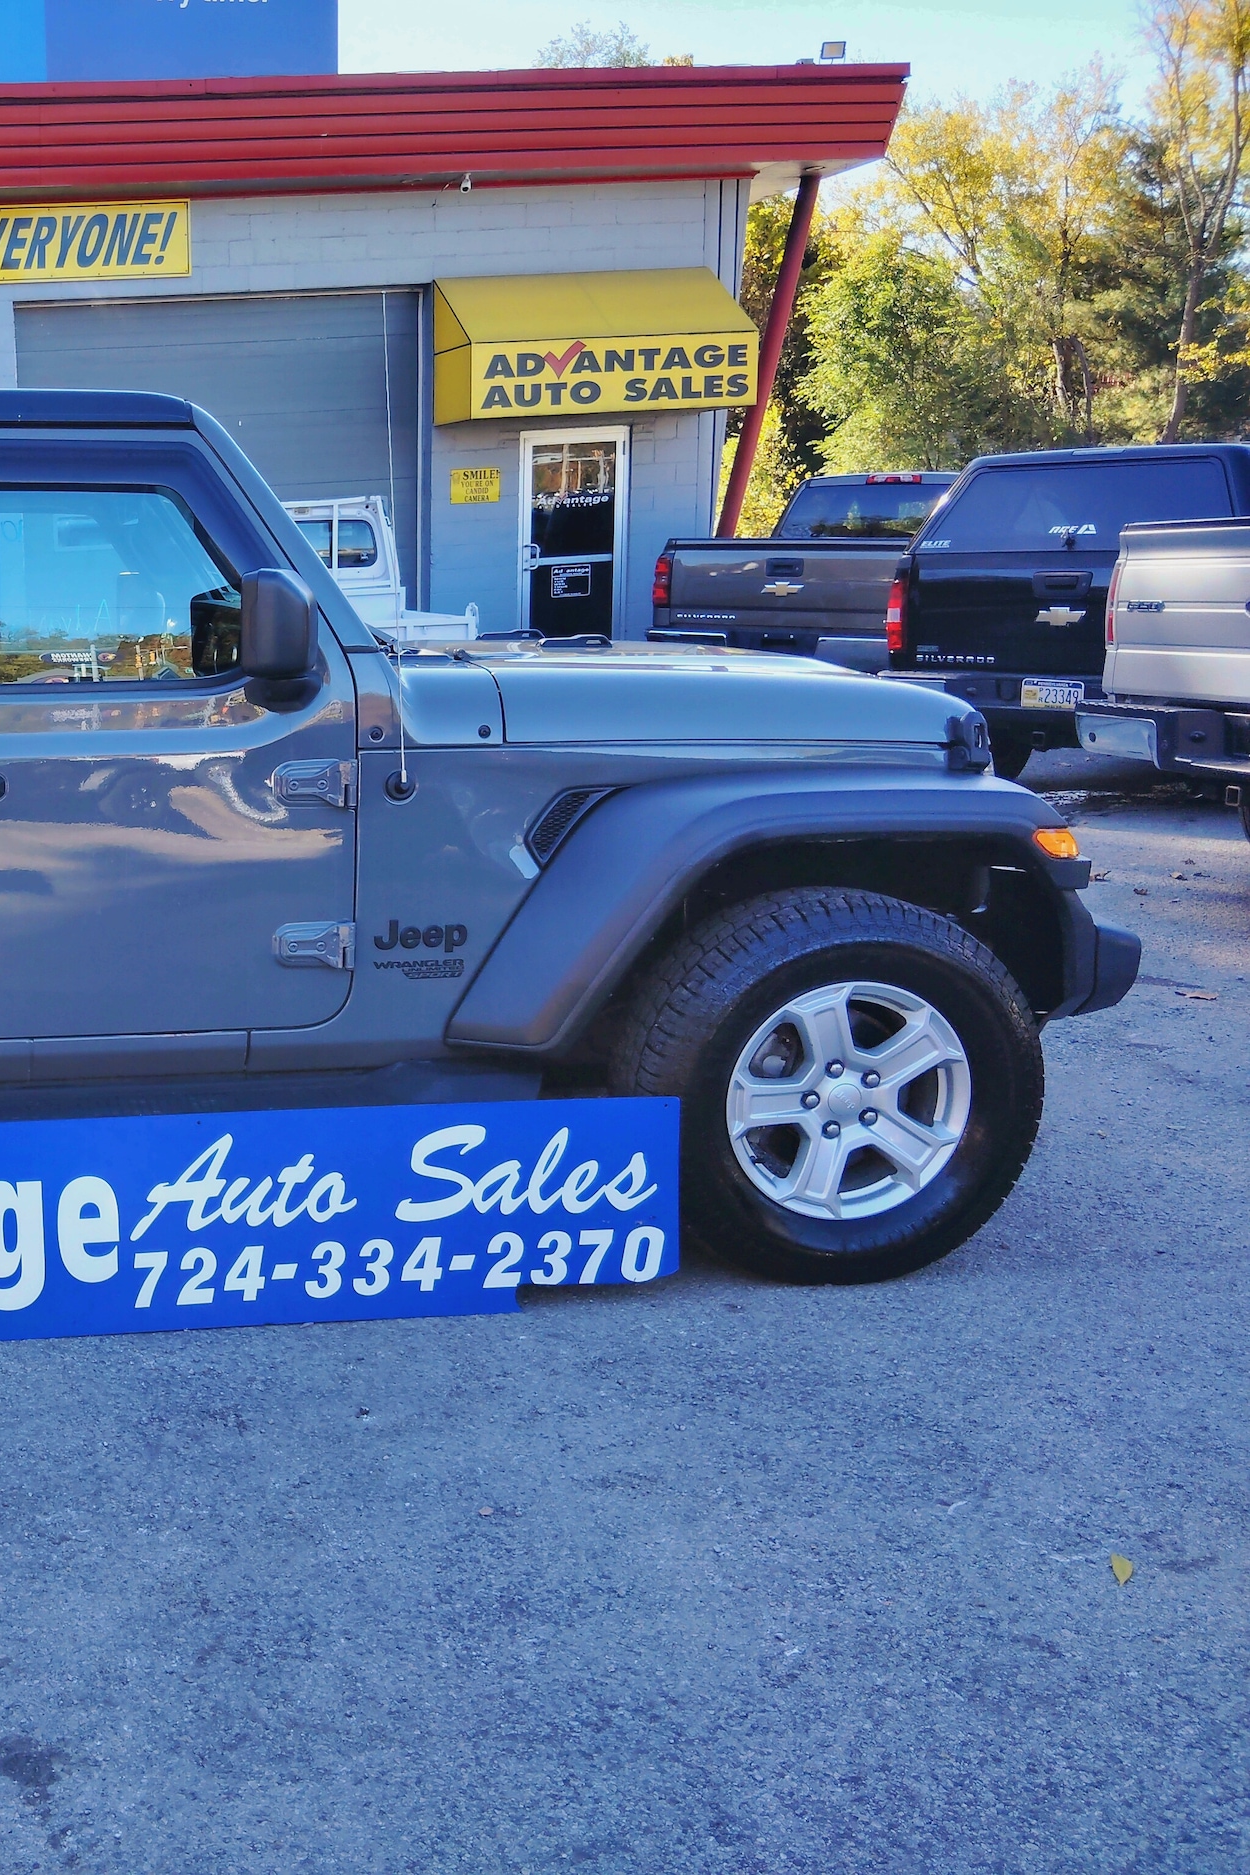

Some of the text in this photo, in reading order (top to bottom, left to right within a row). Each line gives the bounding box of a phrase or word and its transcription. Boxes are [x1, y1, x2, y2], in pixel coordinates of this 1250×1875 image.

[483, 341, 749, 380] ADVANTAGE
[480, 374, 749, 410] AUTO SALES
[462, 469, 499, 481] SMILE!
[485, 479, 494, 487] ON
[465, 487, 489, 495] CANDID
[464, 495, 490, 503] CAMERA
[915, 654, 995, 663] SILVERADO
[373, 919, 468, 953] Jeep
[373, 958, 465, 969] WRANGLER
[130, 1132, 357, 1241] Auto
[395, 1124, 658, 1222] Sales
[133, 1226, 666, 1309] 724-334-2370
